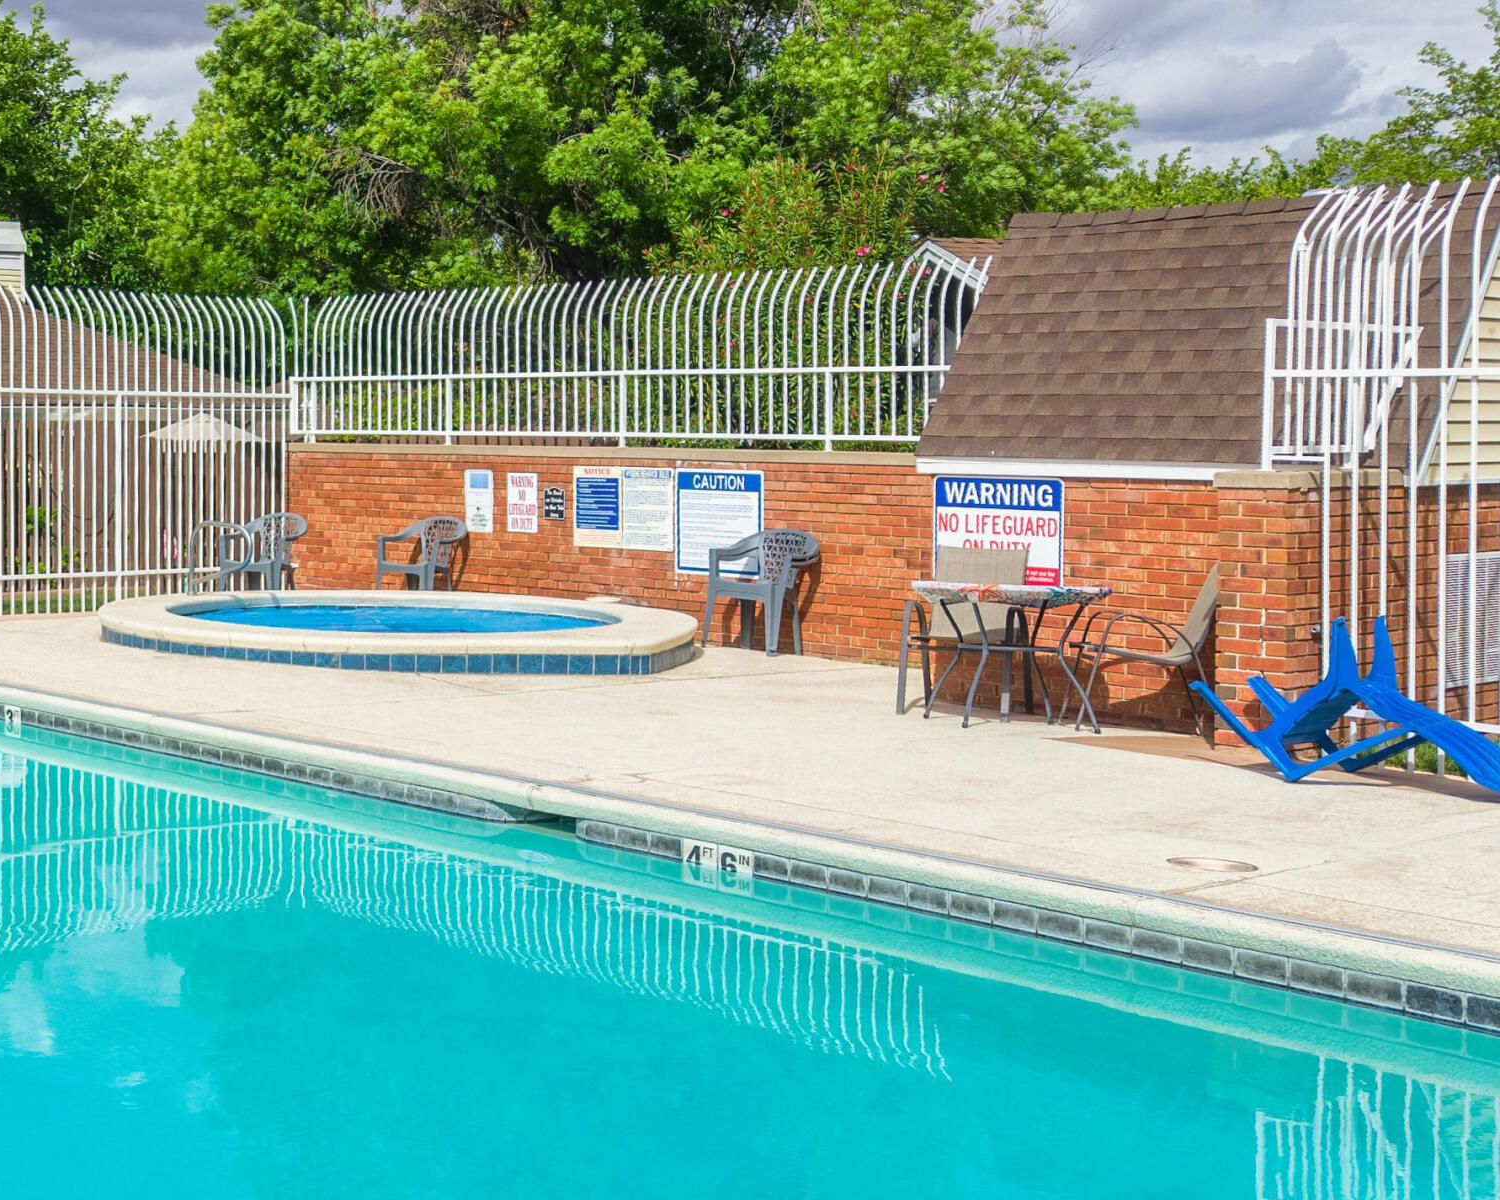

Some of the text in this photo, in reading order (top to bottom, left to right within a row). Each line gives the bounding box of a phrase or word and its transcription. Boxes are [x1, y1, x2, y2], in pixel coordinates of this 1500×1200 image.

[510, 475, 534, 488] WARNING
[693, 474, 745, 490] CAUTION
[518, 490, 526, 501] NO
[944, 481, 1053, 507] WARNING
[508, 503, 537, 515] LIFEGUARD
[938, 512, 1058, 538] NO LIFEGUARD
[6, 709, 13, 723] 3
[686, 845, 750, 873] 4 FT 6 IN
